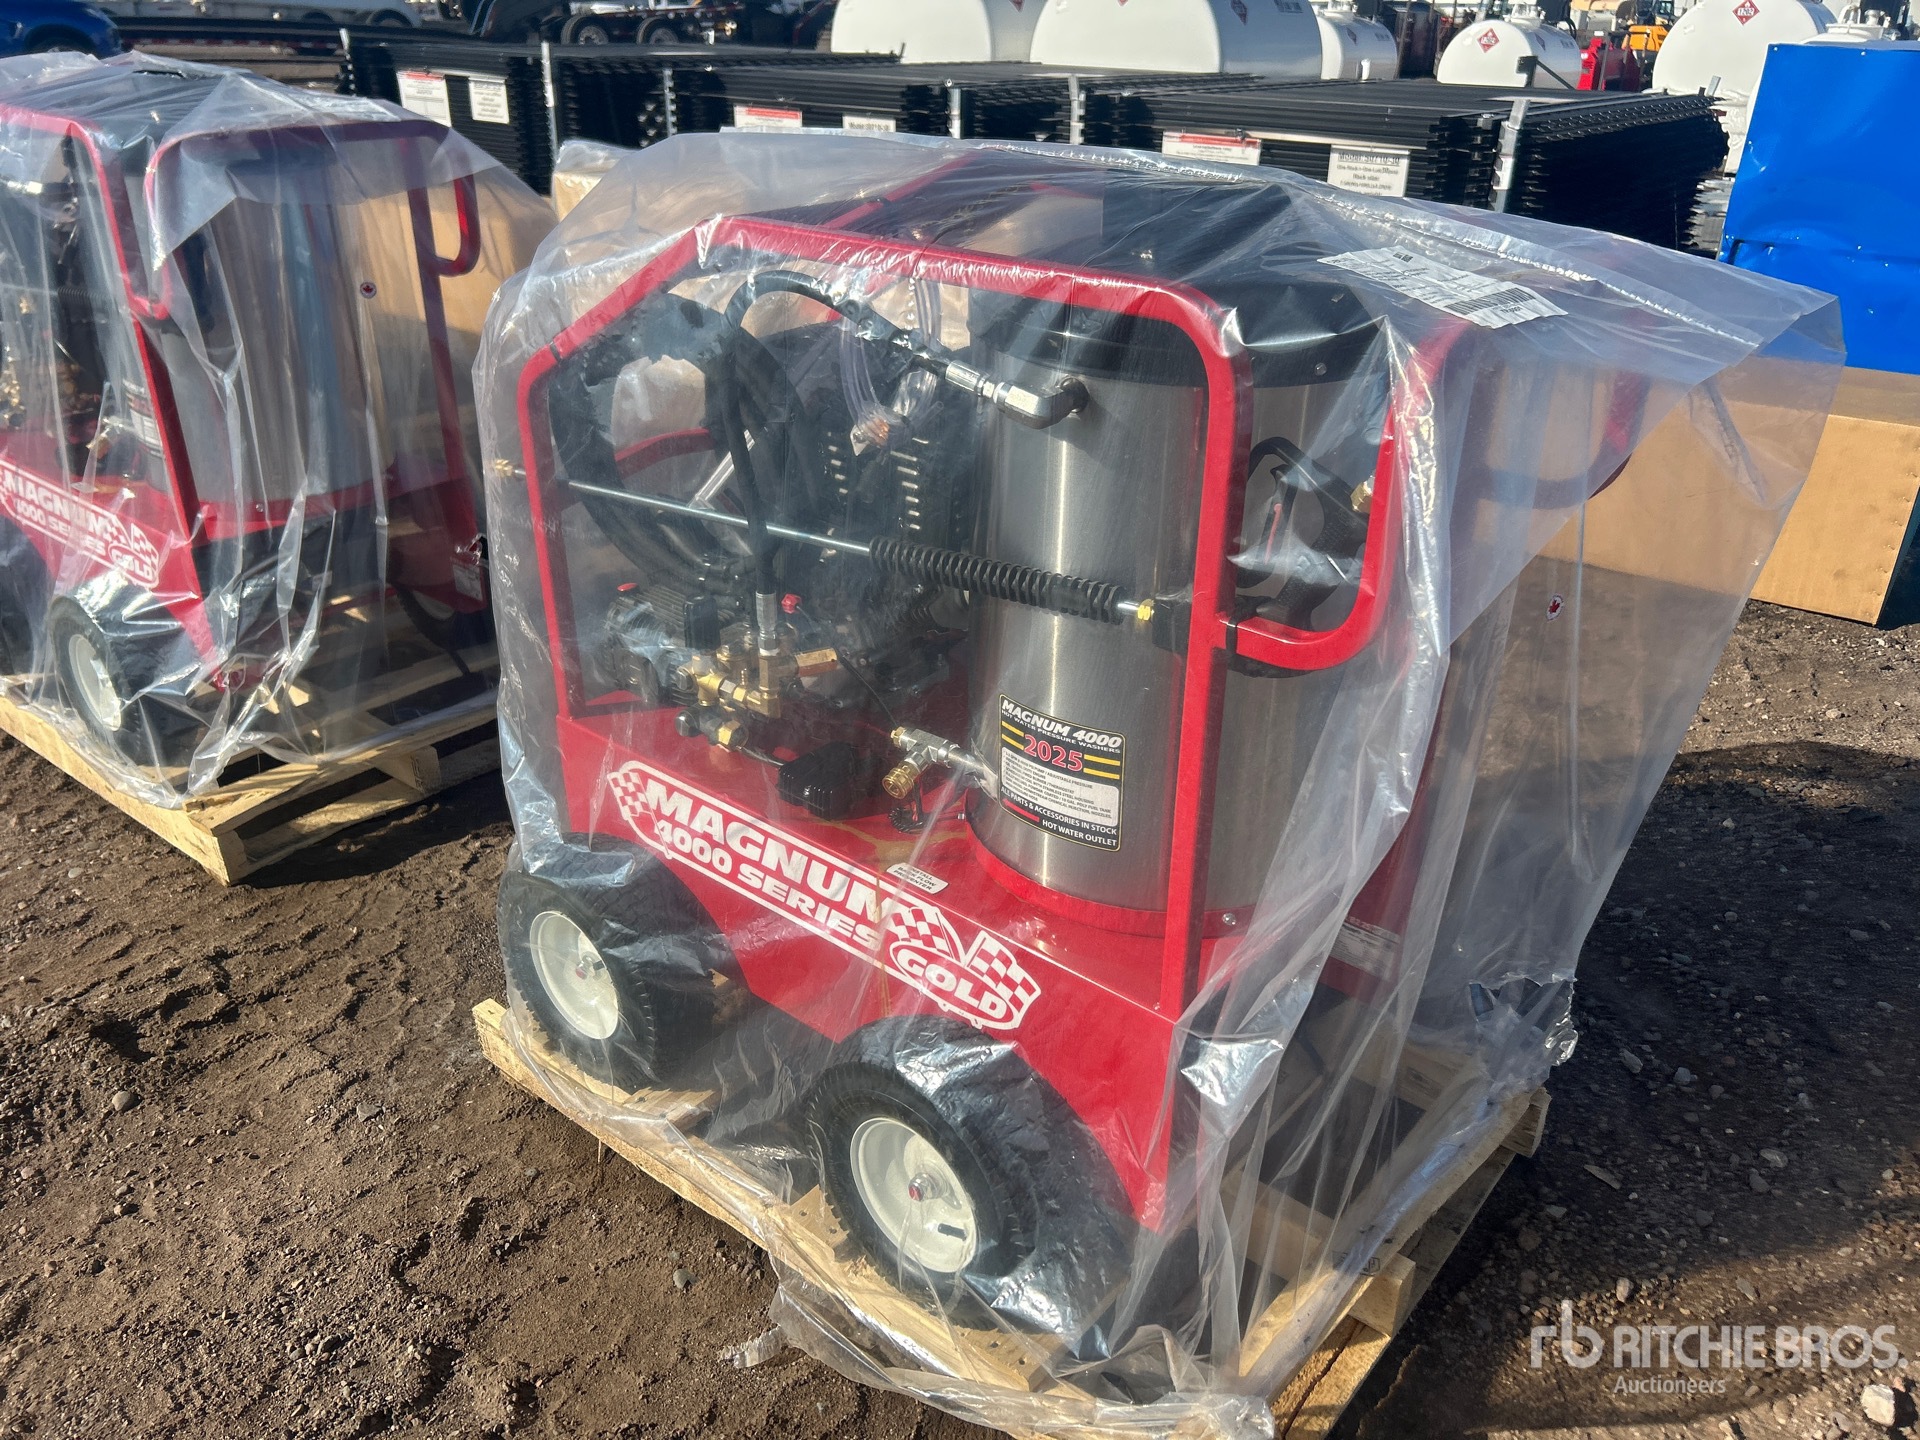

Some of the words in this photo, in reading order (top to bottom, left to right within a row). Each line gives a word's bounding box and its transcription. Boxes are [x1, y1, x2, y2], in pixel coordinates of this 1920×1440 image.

[1002, 699, 1070, 737] MAGNUM
[1073, 730, 1122, 748] 4000
[1002, 709, 1013, 719] HOT
[1014, 717, 1036, 730] WATER
[1038, 728, 1076, 744] PRESSURE
[1079, 741, 1121, 753] WASHERS
[1024, 734, 1083, 771] 2025
[1001, 786, 1010, 796] ALL
[1011, 793, 1028, 806] PARTS
[1034, 806, 1080, 826] ACCESSORIES
[1081, 821, 1089, 830] IN
[1091, 825, 1117, 835] STOCK
[1042, 819, 1057, 830] HOT
[1058, 826, 1083, 839] WATER
[1085, 834, 1117, 846] OUTLET
[647, 778, 897, 923] MAGNUM
[654, 819, 732, 874] 4000
[737, 863, 882, 950] SERIES
[917, 876, 936, 886] FLOW
[897, 948, 1007, 1019] GOLD
